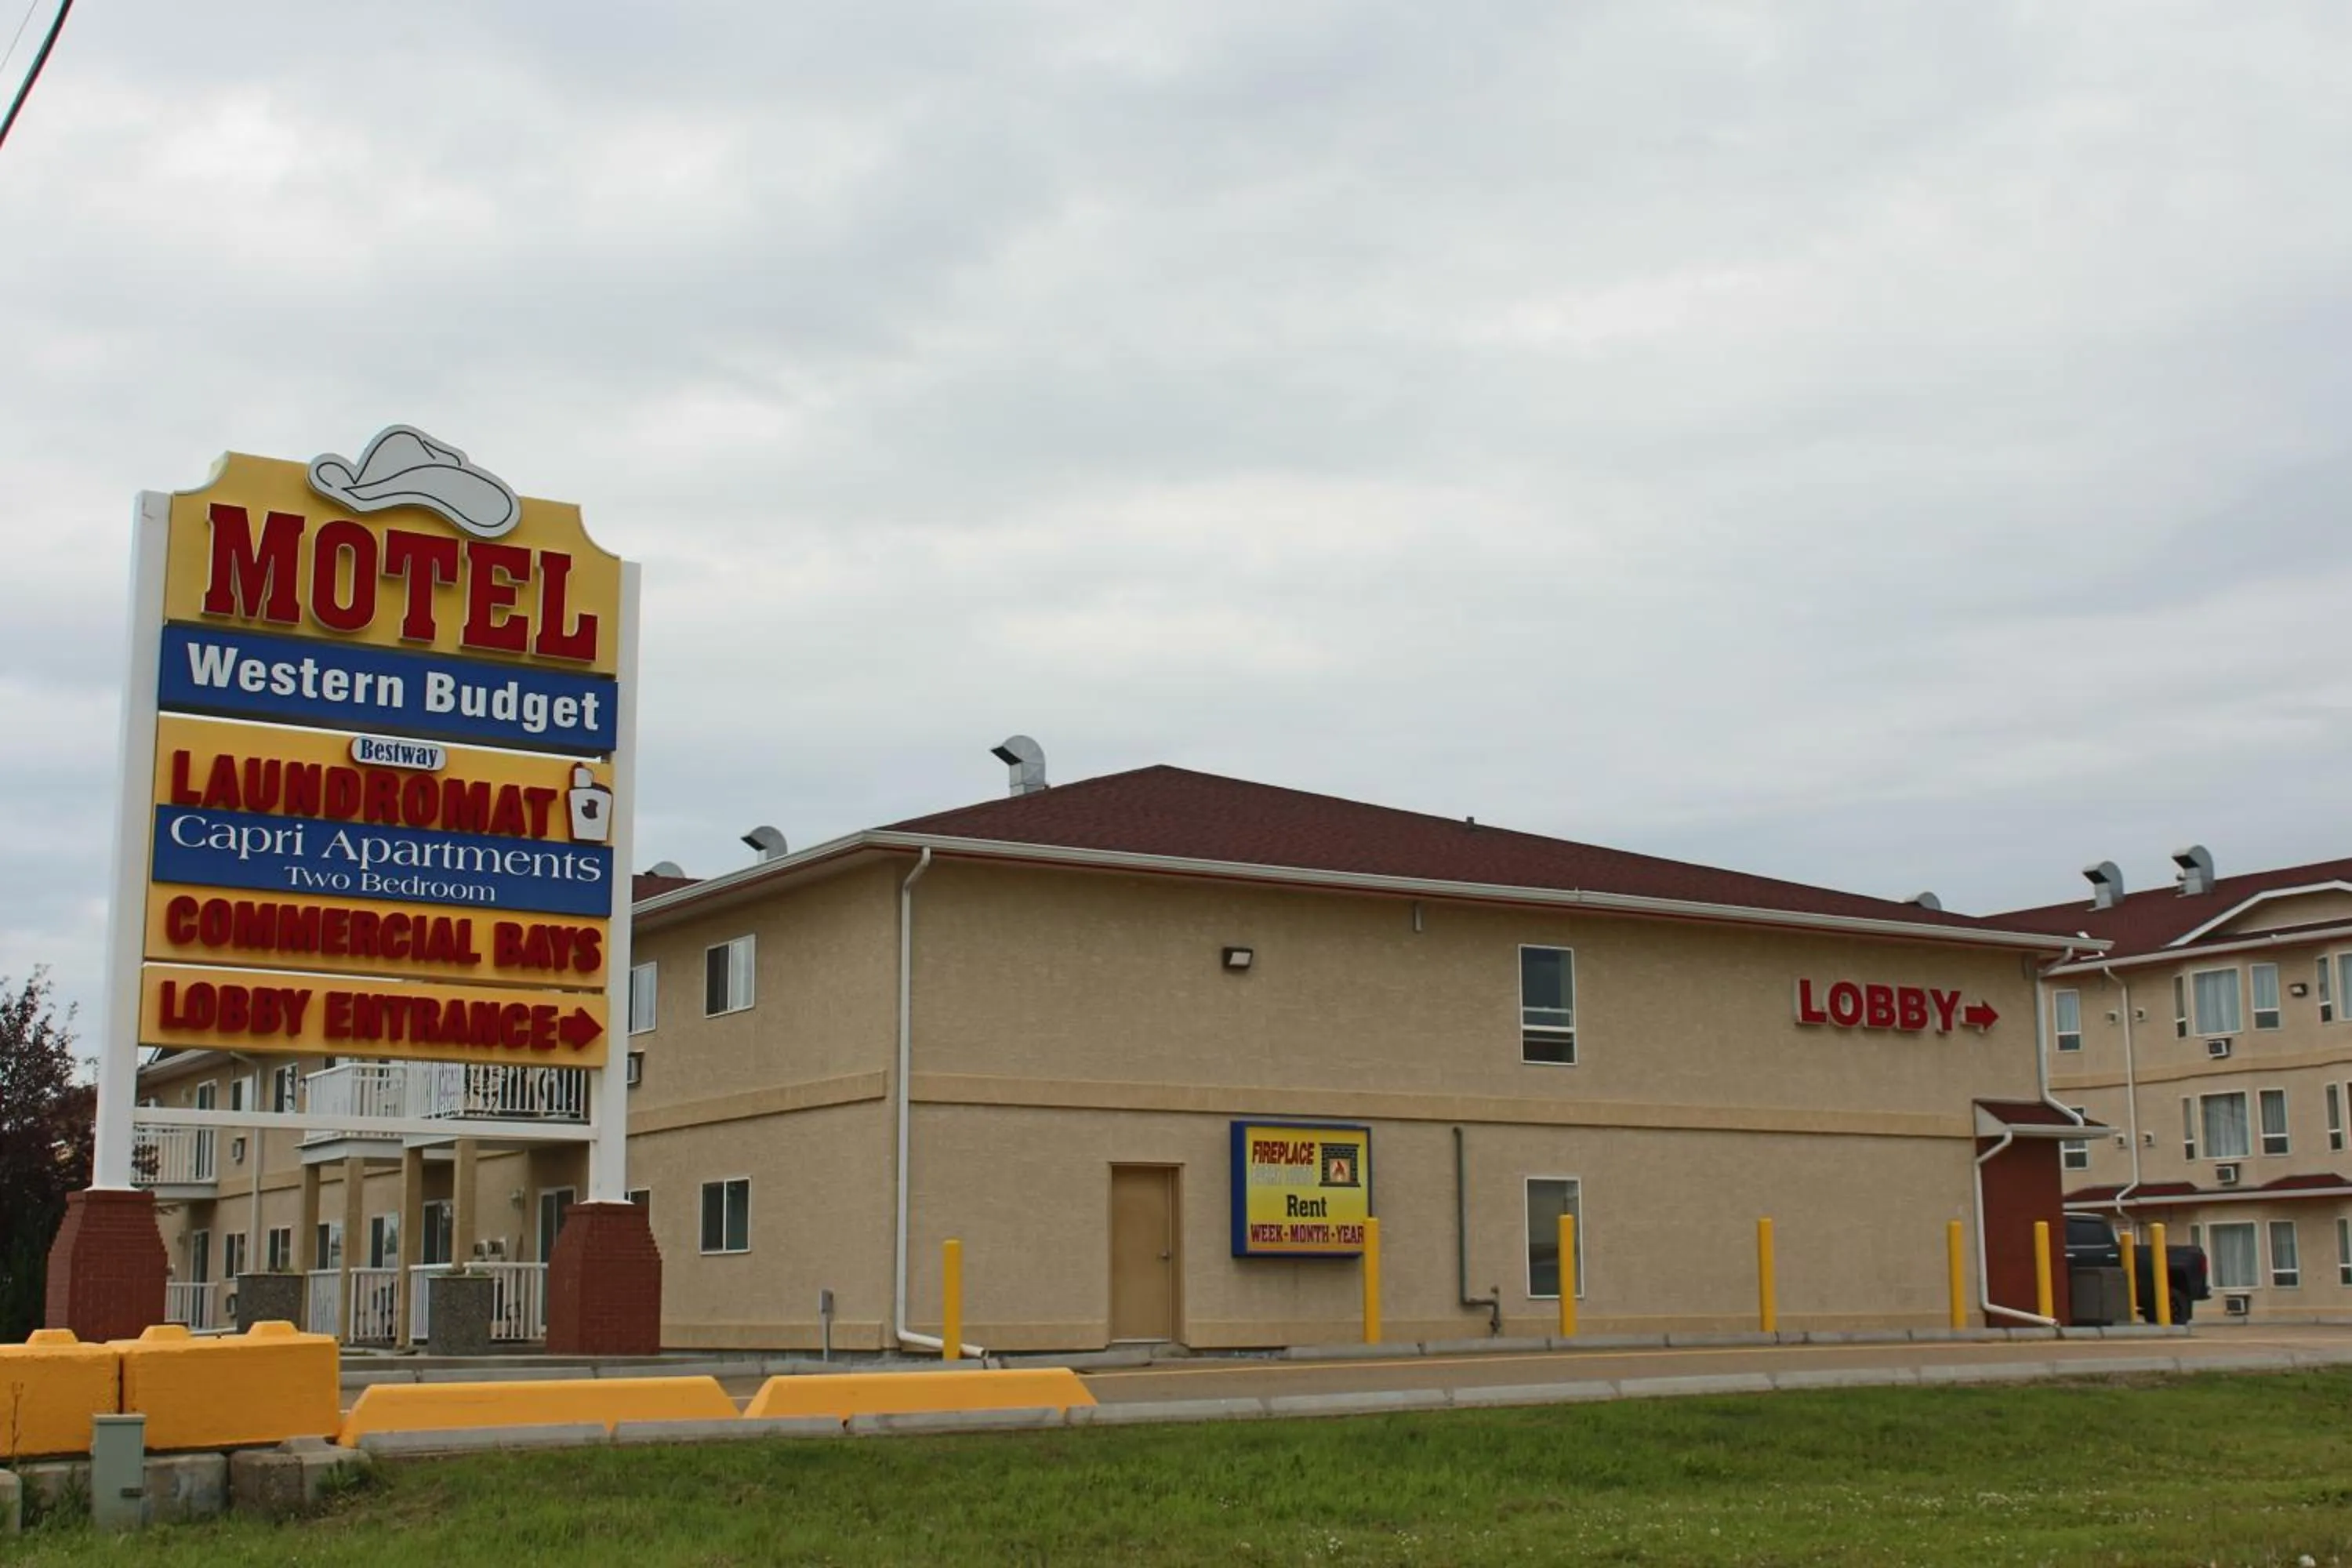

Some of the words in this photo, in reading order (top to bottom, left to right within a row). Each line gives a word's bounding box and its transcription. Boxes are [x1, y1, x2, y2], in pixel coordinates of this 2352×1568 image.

[201, 503, 597, 662] MOTEL
[187, 642, 404, 708] Western
[426, 671, 600, 732] Budget
[361, 738, 438, 768] Bestway
[171, 750, 557, 838] LAUNDROMAT
[170, 814, 303, 860] Capri
[321, 829, 601, 882] Apartments
[284, 866, 350, 889] Two
[361, 872, 495, 902] Bedroom
[165, 895, 481, 965] COMMERCIAL
[494, 920, 602, 973] BAYS
[160, 980, 312, 1036] LOBBY
[324, 990, 559, 1050] ENTRANCE
[1798, 978, 1961, 1033] LOBBY
[1252, 1141, 1315, 1166] FIREPLACE
[1286, 1195, 1327, 1218] Rent
